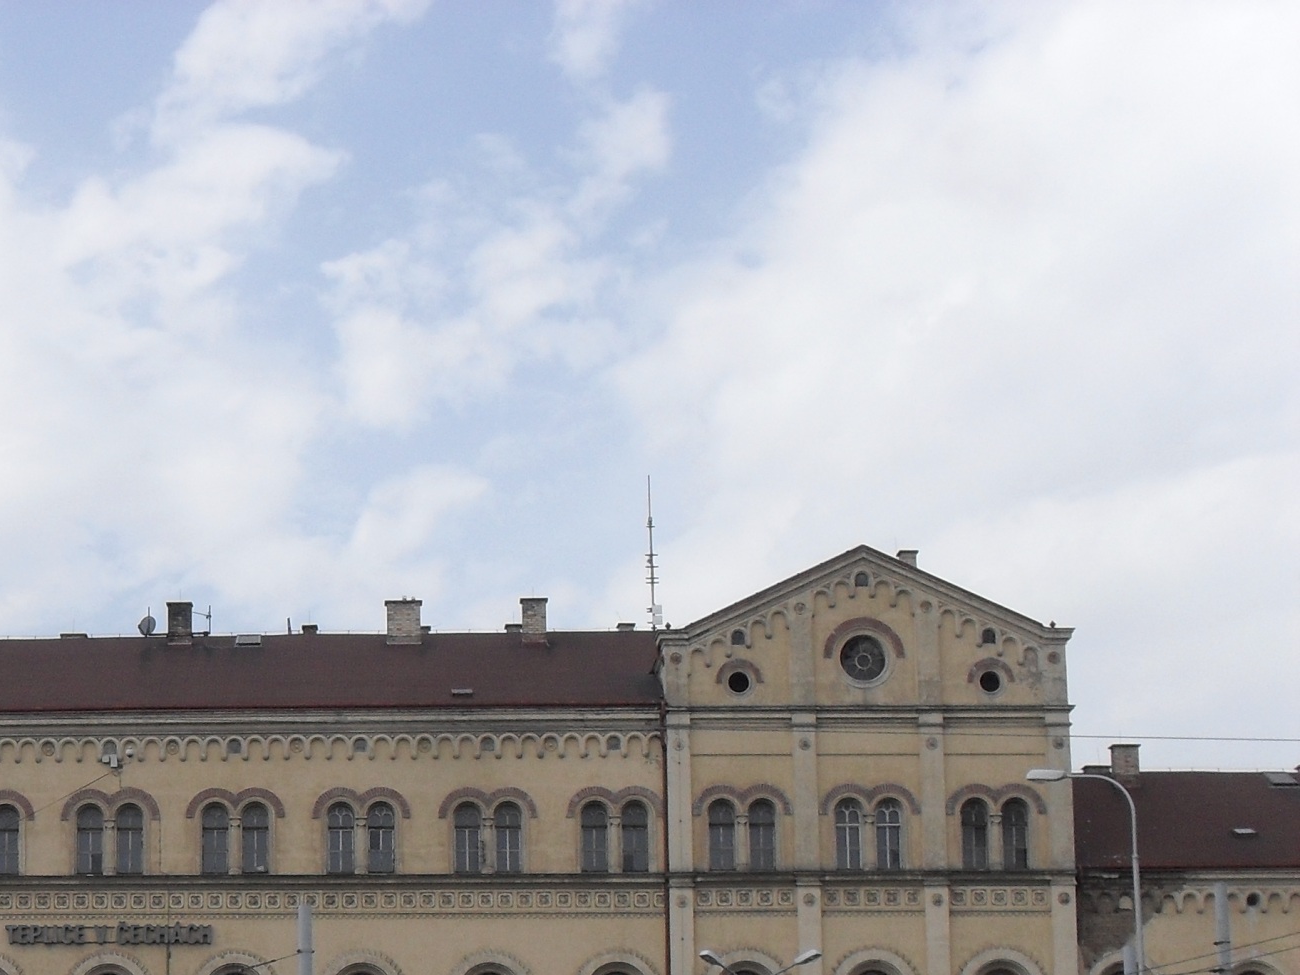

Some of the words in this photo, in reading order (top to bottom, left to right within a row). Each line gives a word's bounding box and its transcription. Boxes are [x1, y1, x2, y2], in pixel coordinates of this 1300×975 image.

[5, 924, 85, 945] TEPLICE
[94, 925, 105, 945] V
[115, 921, 213, 945] ČECHÁCH
